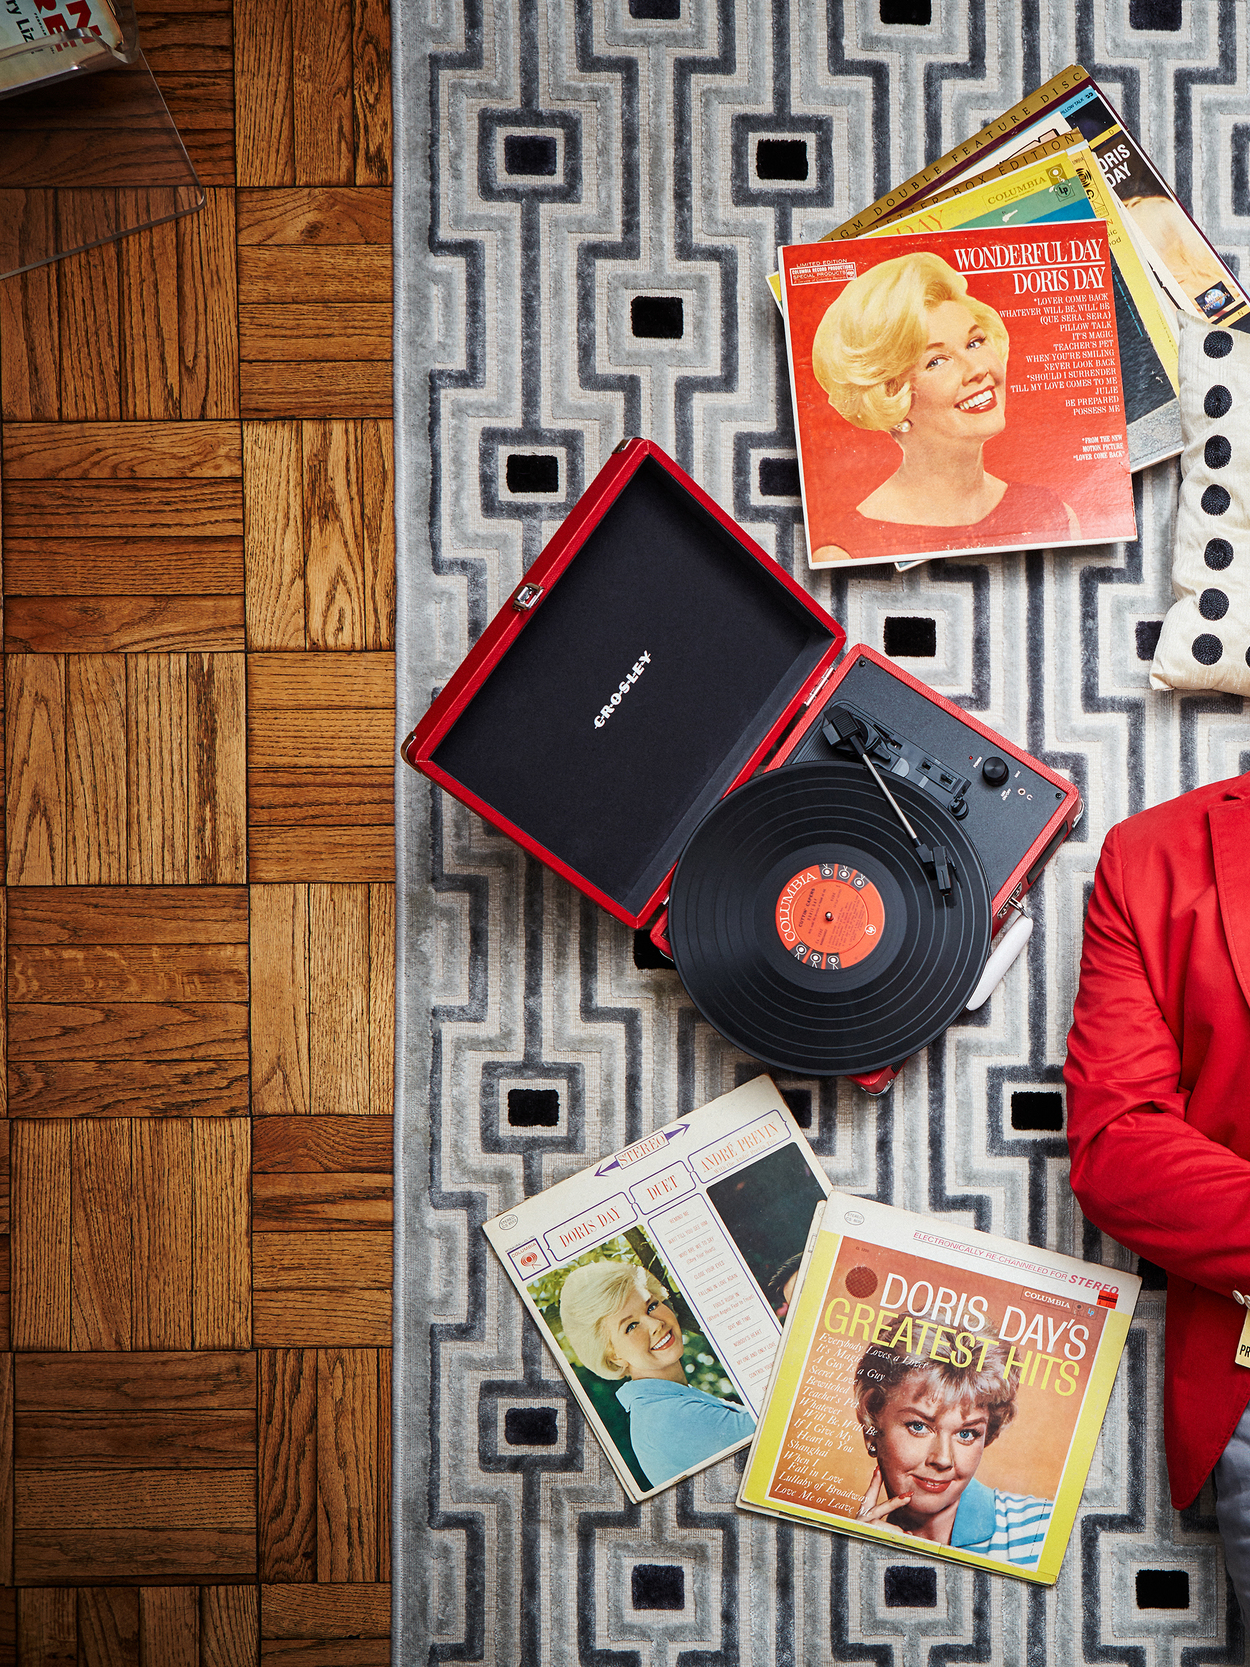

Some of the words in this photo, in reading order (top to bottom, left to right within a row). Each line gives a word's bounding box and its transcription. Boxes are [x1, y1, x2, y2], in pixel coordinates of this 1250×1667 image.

[830, 219, 864, 242] GM
[873, 166, 943, 217] DOUBLE
[951, 106, 1031, 163] FEATURE
[1041, 72, 1083, 104] DISC
[998, 133, 1076, 176] EDITION
[1100, 143, 1131, 173] ORIS
[987, 175, 1047, 206] COLUMBIA
[822, 258, 848, 266] EDITION
[954, 241, 1067, 270] WONDERFUL
[1069, 239, 1103, 261] DAY
[1013, 269, 1069, 295] DORIS
[1073, 267, 1106, 290] DAY
[999, 308, 1041, 318] WHATEVER
[1043, 306, 1064, 315] WILL
[1078, 304, 1098, 313] WILL
[1099, 302, 1110, 311] BE
[1065, 294, 1088, 304] COME
[1088, 293, 1108, 302] BACK
[1040, 315, 1059, 325] (QUE
[1086, 311, 1111, 321] SERA)
[1059, 323, 1089, 332] PILLOW
[1091, 321, 1112, 330] TALK
[1053, 341, 1097, 351] TEACHER'S
[1099, 340, 1114, 348] PET
[1072, 331, 1087, 340] IT'S
[1088, 330, 1113, 339] MAGIC
[1026, 354, 1050, 363] WHEN
[1051, 352, 1081, 361] YOU'RE
[1082, 349, 1115, 358] SMILING
[1044, 362, 1071, 371] NEVER
[1072, 360, 1094, 369] LOOK
[1095, 358, 1116, 367] BACK
[1068, 368, 1117, 378] SURRENDER
[1010, 385, 1029, 393] TILL
[1030, 383, 1042, 391] MY
[1044, 381, 1065, 390] LOVE
[1066, 379, 1092, 388] COMES
[1093, 378, 1104, 386] TO
[1105, 377, 1117, 385] ME
[1095, 386, 1118, 395] JULIE
[1065, 399, 1076, 407] BE
[1077, 396, 1119, 406] PREPARED
[1073, 406, 1107, 416] POSSESS
[1108, 405, 1120, 413] ME
[594, 650, 652, 730] CROSLEY
[780, 872, 818, 942] COLUMBIA
[617, 1135, 667, 1168] STEREO
[700, 1142, 739, 1173] ANDRÉ
[736, 1122, 779, 1152] PREVIN
[647, 1174, 680, 1201] DUET
[559, 1219, 597, 1248] DORIS
[597, 1206, 623, 1228] DAY
[511, 1242, 537, 1258] COLUMBIA
[913, 1231, 985, 1256] ELECTRONICALLY
[985, 1251, 1049, 1275] RE-CHANNELED
[1049, 1270, 1068, 1281] FOR
[1068, 1274, 1119, 1295] STEREO
[1024, 1290, 1071, 1309] COLUMBIA
[879, 1272, 988, 1333] DORIS
[998, 1305, 1090, 1361] DAY'S
[816, 1343, 831, 1355] It's
[833, 1348, 864, 1363] Magic
[819, 1332, 864, 1354] Everybody
[865, 1345, 892, 1360] Loves
[902, 1355, 929, 1369] Lover
[824, 1297, 999, 1373] GREATEST
[1002, 1345, 1080, 1397] HITS
[809, 1364, 834, 1379] Secret
[836, 1372, 858, 1385] Love
[812, 1355, 824, 1364] A
[825, 1358, 845, 1371] Guy
[846, 1363, 857, 1373] Is
[866, 1368, 886, 1382] Guy
[806, 1375, 851, 1394] Bewitched
[799, 1397, 843, 1416] Whatever
[802, 1385, 841, 1403] Teacher's
[843, 1397, 860, 1409] Pet
[793, 1417, 806, 1429] If
[805, 1421, 813, 1430] I
[813, 1423, 835, 1437] Give
[835, 1429, 853, 1442] My
[803, 1408, 827, 1422] Will
[841, 1419, 865, 1432] Will
[865, 1425, 878, 1437] Be
[787, 1438, 831, 1458] Shanghai
[796, 1430, 824, 1445] Heart
[824, 1438, 834, 1447] to
[836, 1440, 855, 1453] You
[783, 1450, 810, 1465] When
[812, 1458, 820, 1467] I
[787, 1461, 809, 1474] Fall
[809, 1467, 819, 1478] in
[821, 1470, 844, 1484] Love
[778, 1471, 813, 1489] Lullaby
[814, 1482, 827, 1492] of
[825, 1484, 870, 1505] Broadway
[774, 1483, 797, 1497] Love
[798, 1490, 813, 1502] Me
[815, 1496, 827, 1504] or
[827, 1497, 855, 1514] Leave
[856, 1506, 873, 1518] Me
